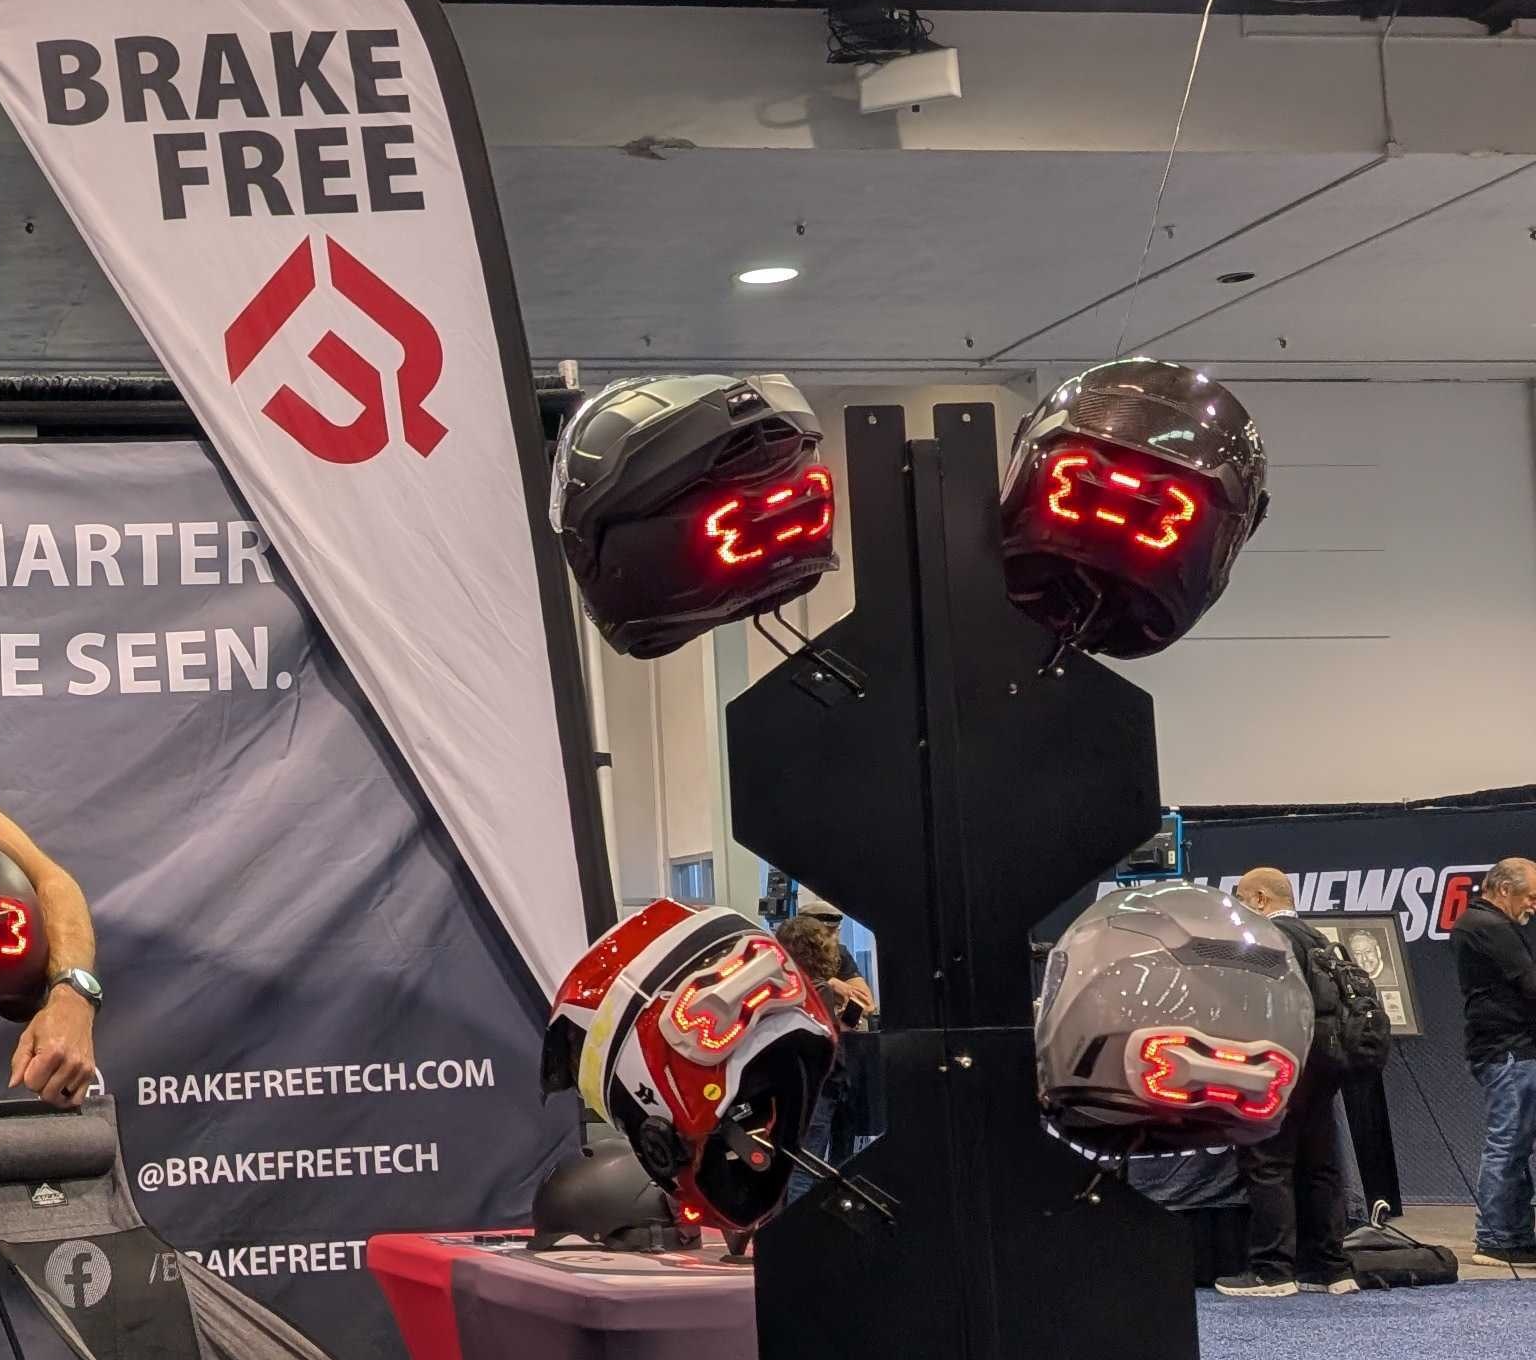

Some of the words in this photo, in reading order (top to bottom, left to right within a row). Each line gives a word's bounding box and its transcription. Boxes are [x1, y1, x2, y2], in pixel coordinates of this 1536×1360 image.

[36, 29, 411, 126] BRAKE
[153, 125, 425, 220] FREE
[66, 626, 293, 696] SEEN.
[138, 1058, 495, 1106] BRAKEFREETECH.COM
[137, 1142, 439, 1192] @BRAKEFREETECH
